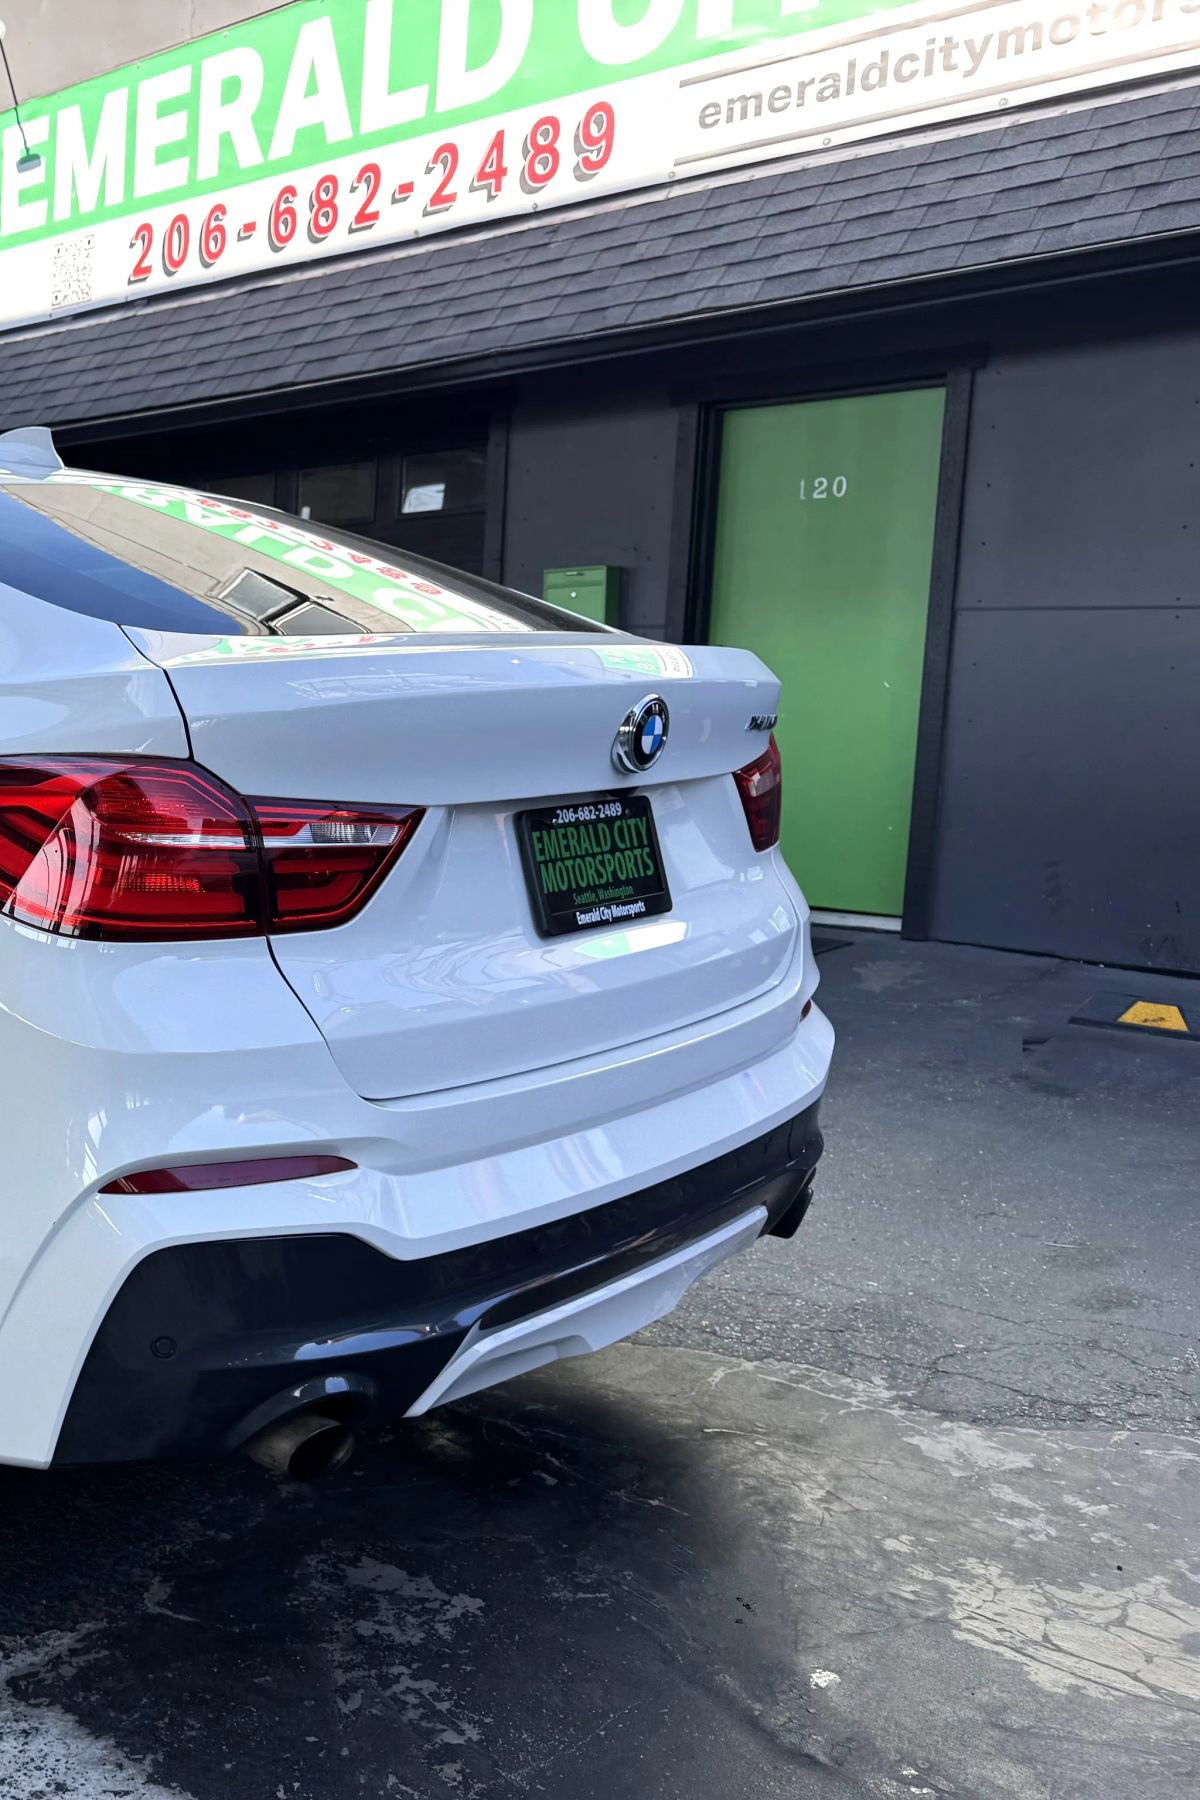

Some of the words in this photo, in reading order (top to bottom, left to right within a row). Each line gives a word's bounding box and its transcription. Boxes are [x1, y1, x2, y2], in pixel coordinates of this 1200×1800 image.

[0, 0, 534, 237] EMERALD
[128, 100, 616, 284] 206-682-2489
[800, 475, 847, 500] 120
[556, 801, 622, 824] 206-682-2489
[532, 822, 611, 862] EMERALD
[613, 816, 648, 849] CITY
[540, 847, 655, 894] MOTORSPORTS
[597, 884, 635, 900] Washington
[576, 907, 601, 925] Emerald
[600, 905, 612, 922] City
[611, 900, 646, 918] Motorsports
